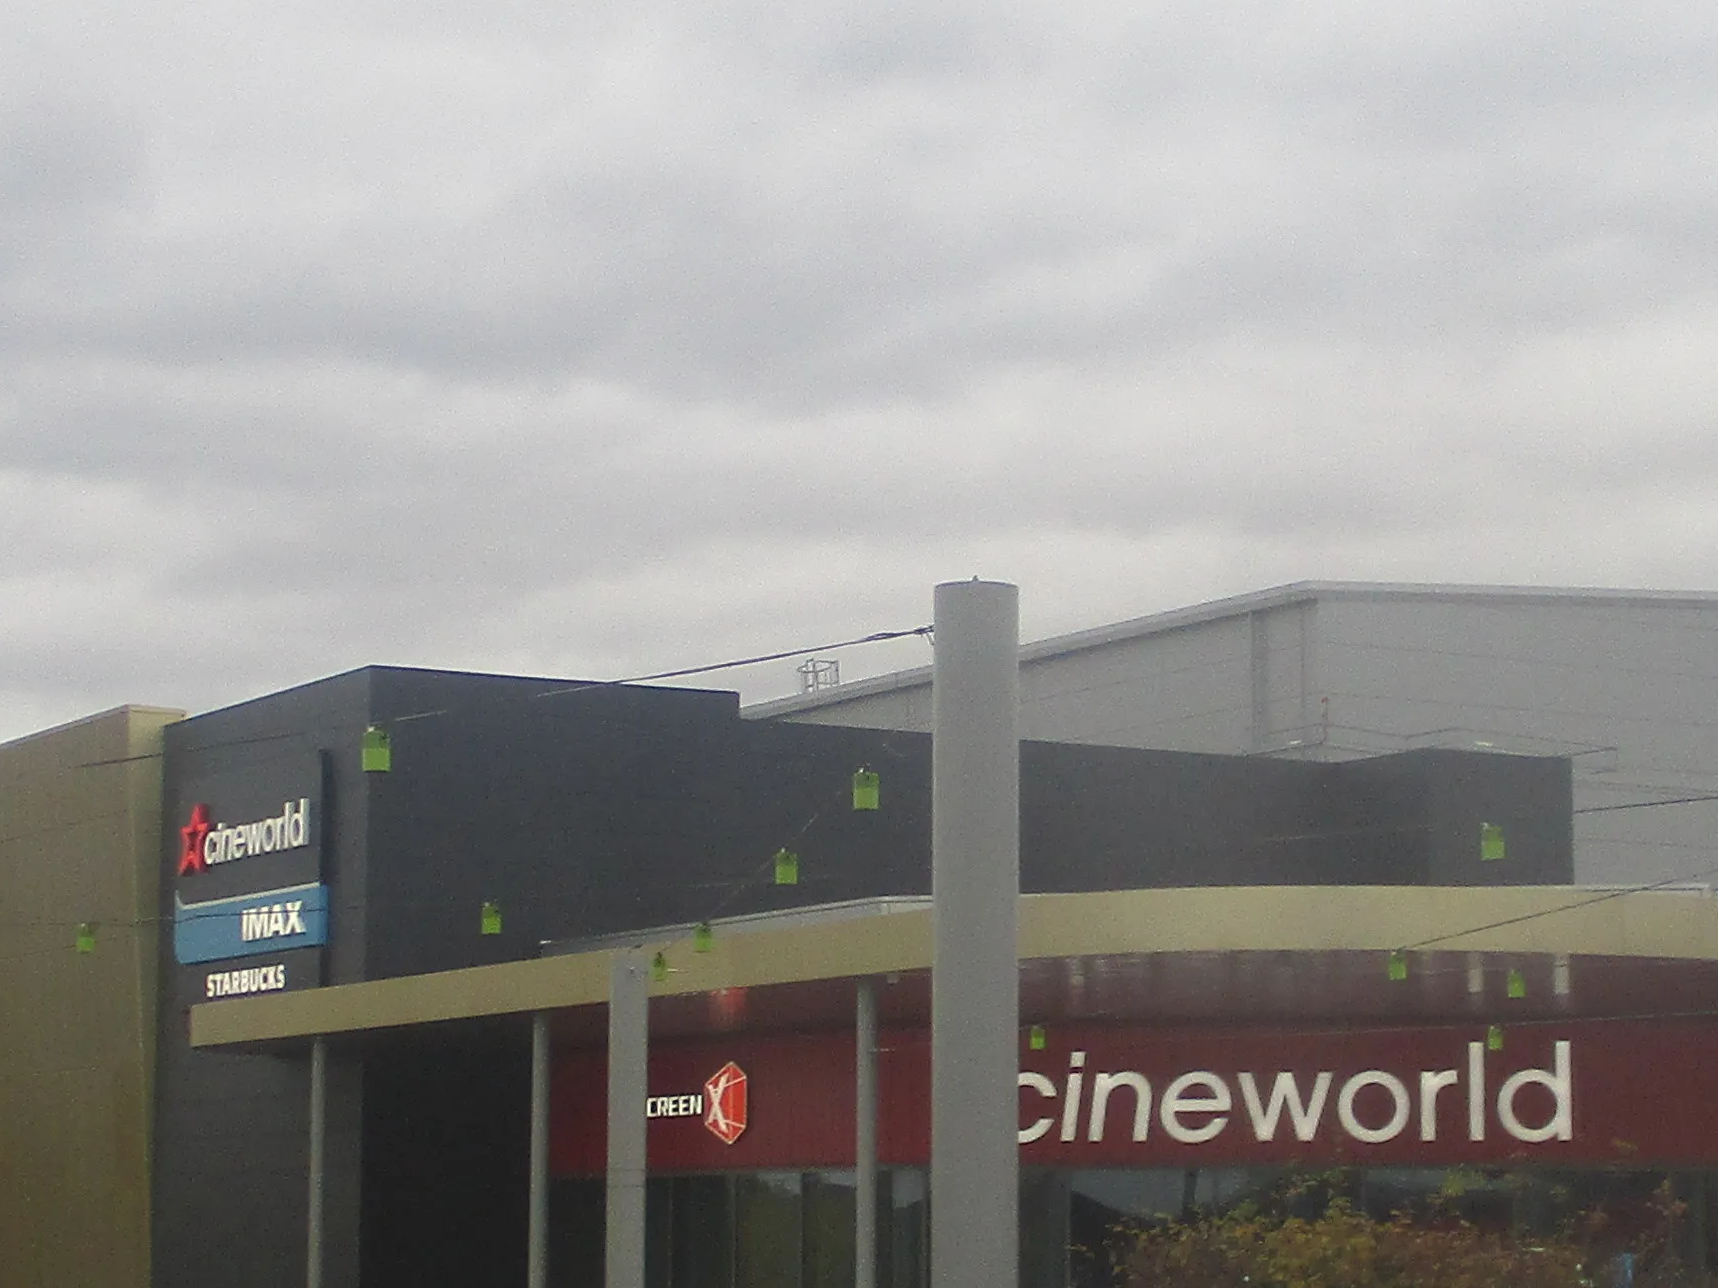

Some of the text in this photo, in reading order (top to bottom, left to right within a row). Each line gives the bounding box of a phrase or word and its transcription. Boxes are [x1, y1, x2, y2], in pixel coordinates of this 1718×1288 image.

[204, 798, 310, 865] cineworld
[241, 900, 306, 942] IMAX
[205, 964, 285, 998] STARBUCKS
[646, 1095, 702, 1117] CREEN
[1018, 1040, 1572, 1144] cineworld
